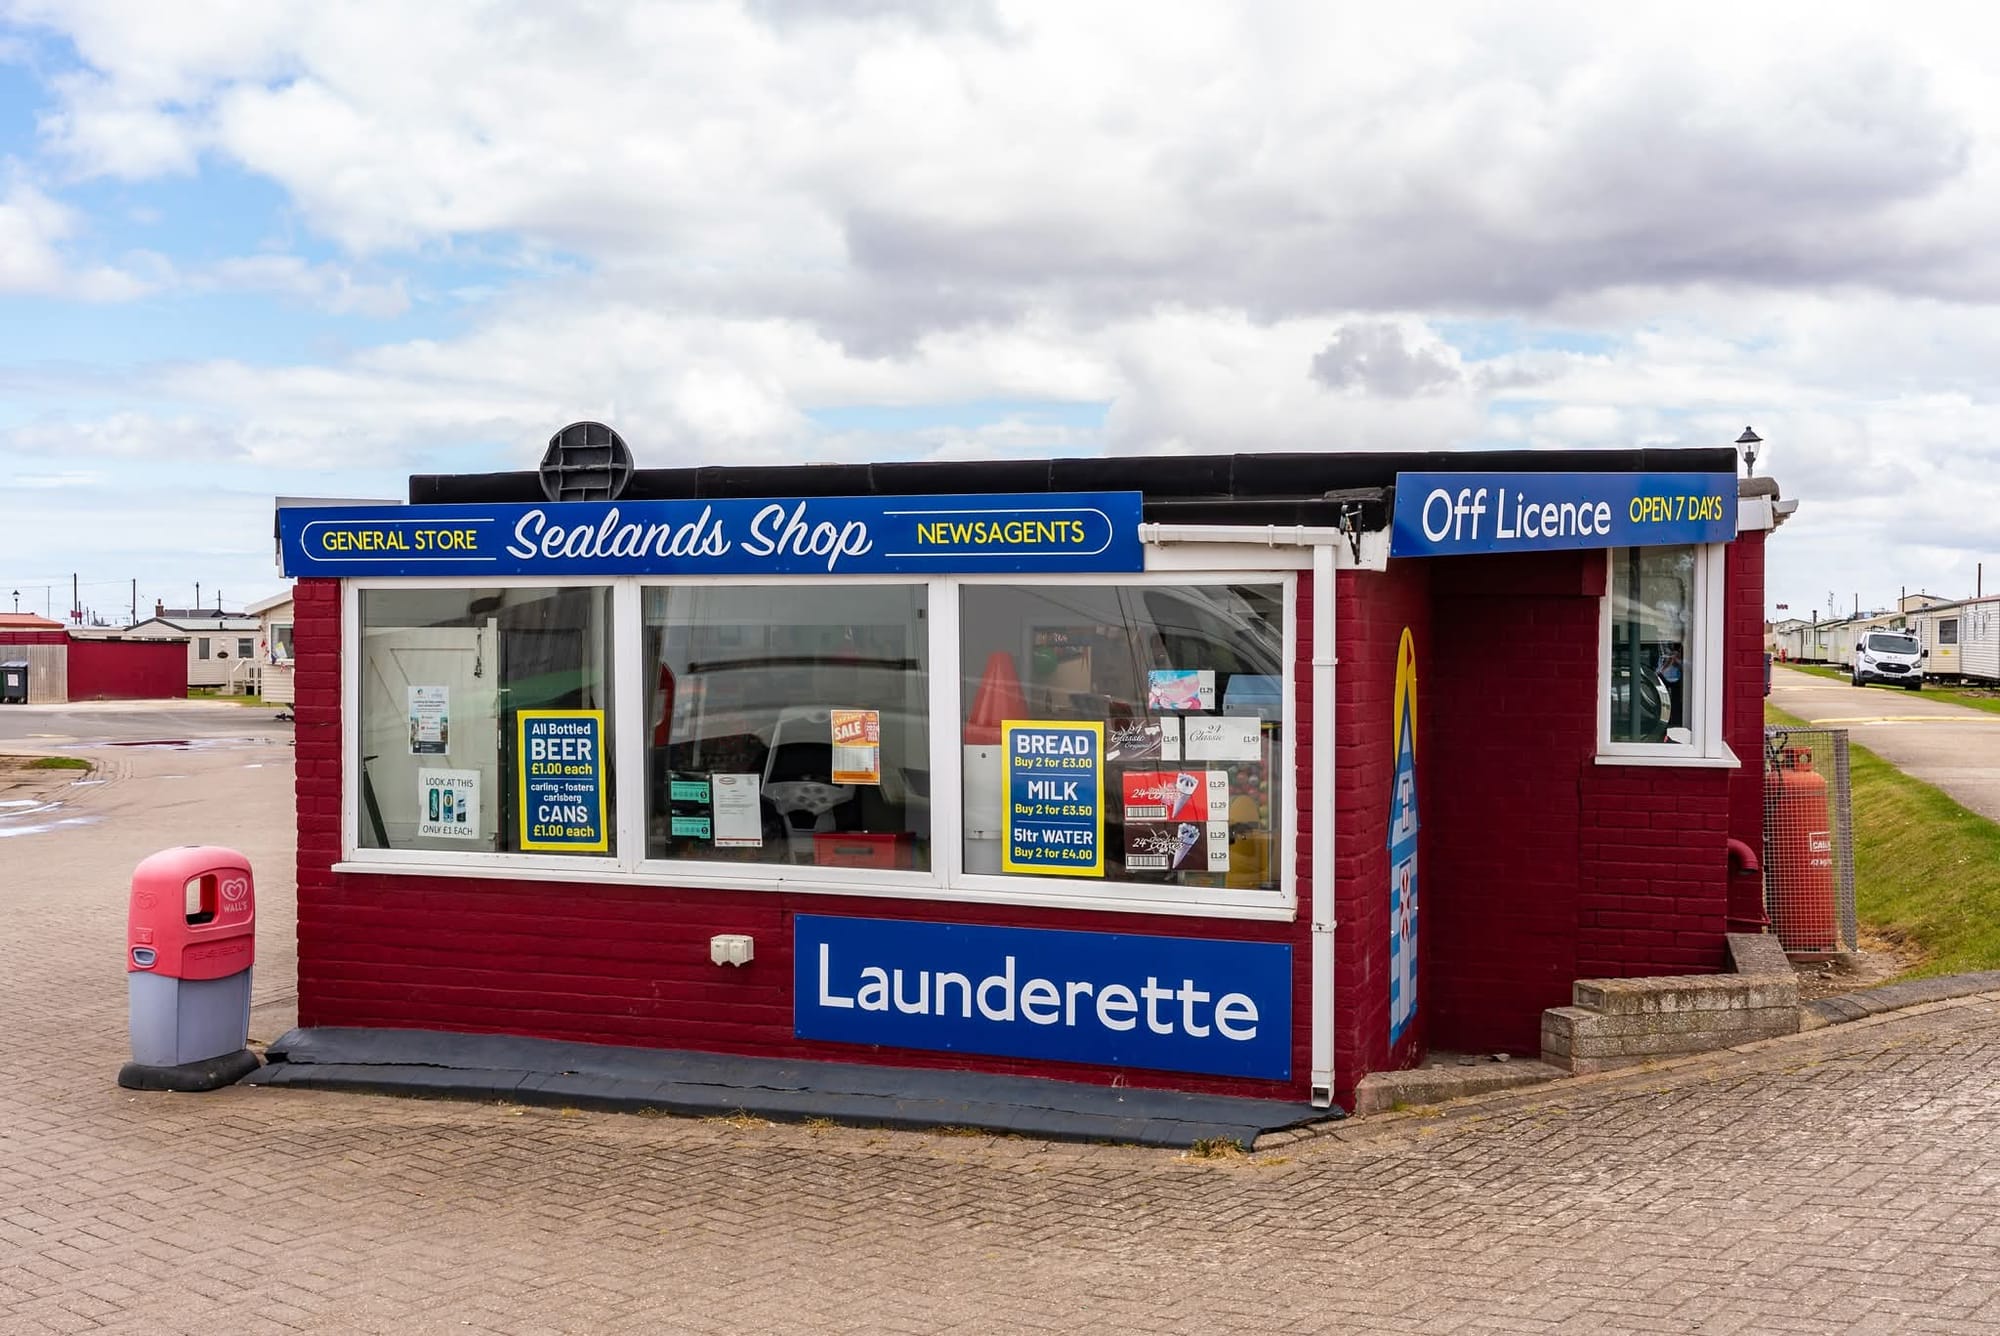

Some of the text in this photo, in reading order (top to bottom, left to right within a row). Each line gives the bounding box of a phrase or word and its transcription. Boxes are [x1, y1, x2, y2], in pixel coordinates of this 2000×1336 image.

[1422, 487, 1611, 542] Off Licence
[1629, 495, 1723, 523] OPEN 7 DAYS
[506, 500, 873, 572] Sealands Shop
[917, 520, 1085, 544] NEWSAGENTS
[322, 529, 478, 551] GENERAL STORE
[532, 723, 591, 735] All Bottled
[834, 721, 861, 740] SALE
[1190, 730, 1223, 742] Classic
[531, 738, 592, 761] BEER
[1017, 735, 1089, 755] BREAD
[531, 762, 593, 775] £1.00 each
[1014, 757, 1092, 769] Buy 2 for £3.00
[426, 777, 445, 786] LOOK
[457, 779, 474, 788] THIS
[531, 782, 559, 793] carling
[565, 782, 594, 792] fosters
[1028, 781, 1078, 800] MILK
[1132, 789, 1145, 798] 24
[543, 793, 582, 804] carlsberg
[538, 805, 588, 823] CANS
[1015, 804, 1092, 816] Buy 2 for £3.50
[423, 824, 473, 836] ONLY £1 EACH
[533, 824, 595, 837] £1.00 each
[1014, 828, 1093, 845] 5ltr WATER
[1132, 838, 1146, 847] 24
[1014, 847, 1092, 860] Buy 2 for £4.00
[223, 901, 248, 913] WALL'S
[818, 942, 1260, 1041] Launderette
